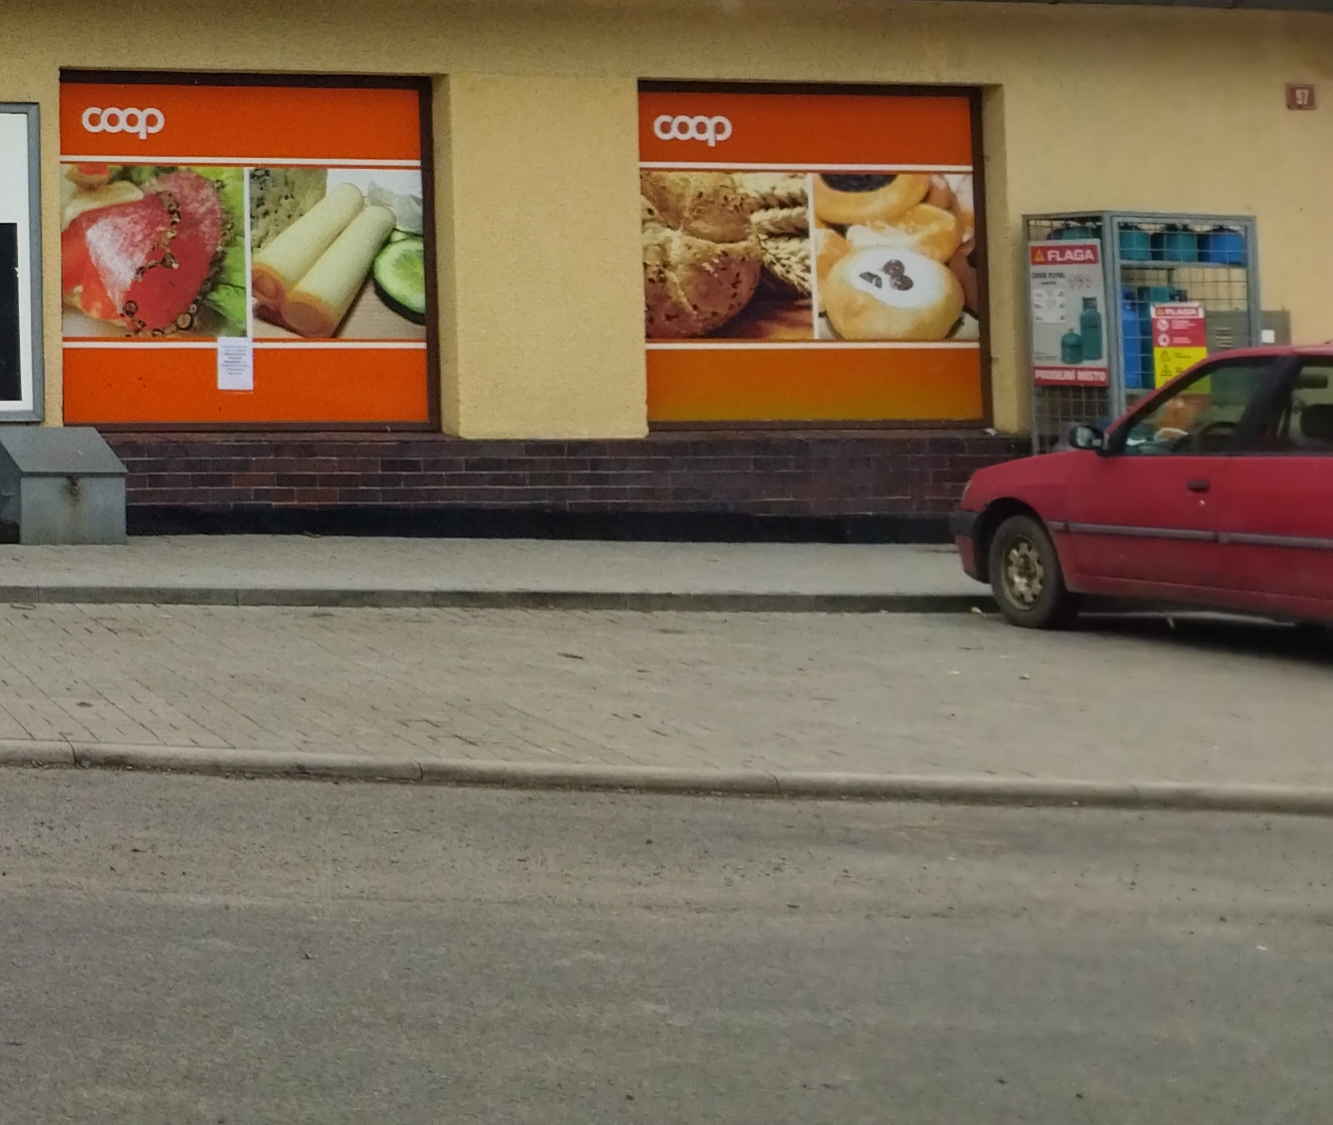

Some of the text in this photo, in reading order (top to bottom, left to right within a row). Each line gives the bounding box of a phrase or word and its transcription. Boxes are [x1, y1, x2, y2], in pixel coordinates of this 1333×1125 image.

[81, 107, 165, 140] coop
[653, 115, 732, 147] coop
[1047, 249, 1095, 262] FLAGA
